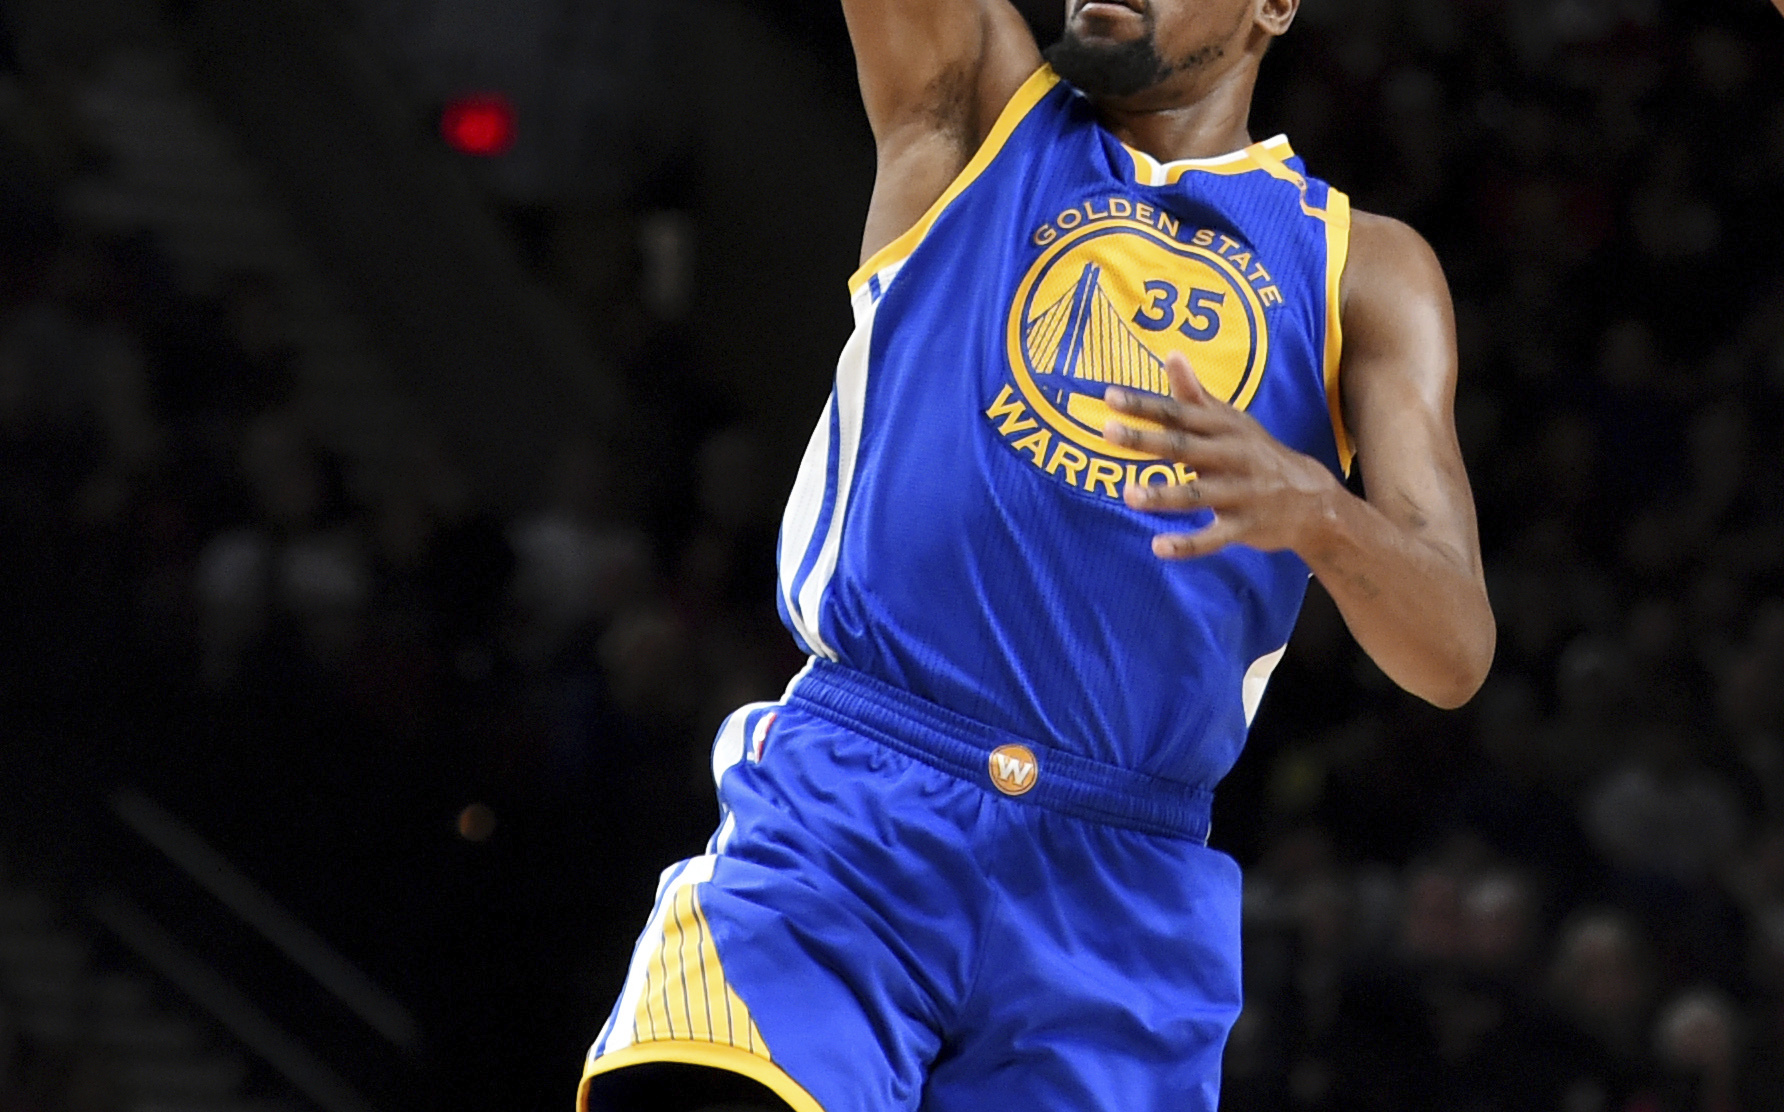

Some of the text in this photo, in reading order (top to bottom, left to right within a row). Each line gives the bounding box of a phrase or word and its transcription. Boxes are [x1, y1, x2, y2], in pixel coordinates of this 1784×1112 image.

[1033, 197, 1284, 308] GOLDEN STATE
[1131, 279, 1226, 343] 35
[995, 752, 1033, 786] W
